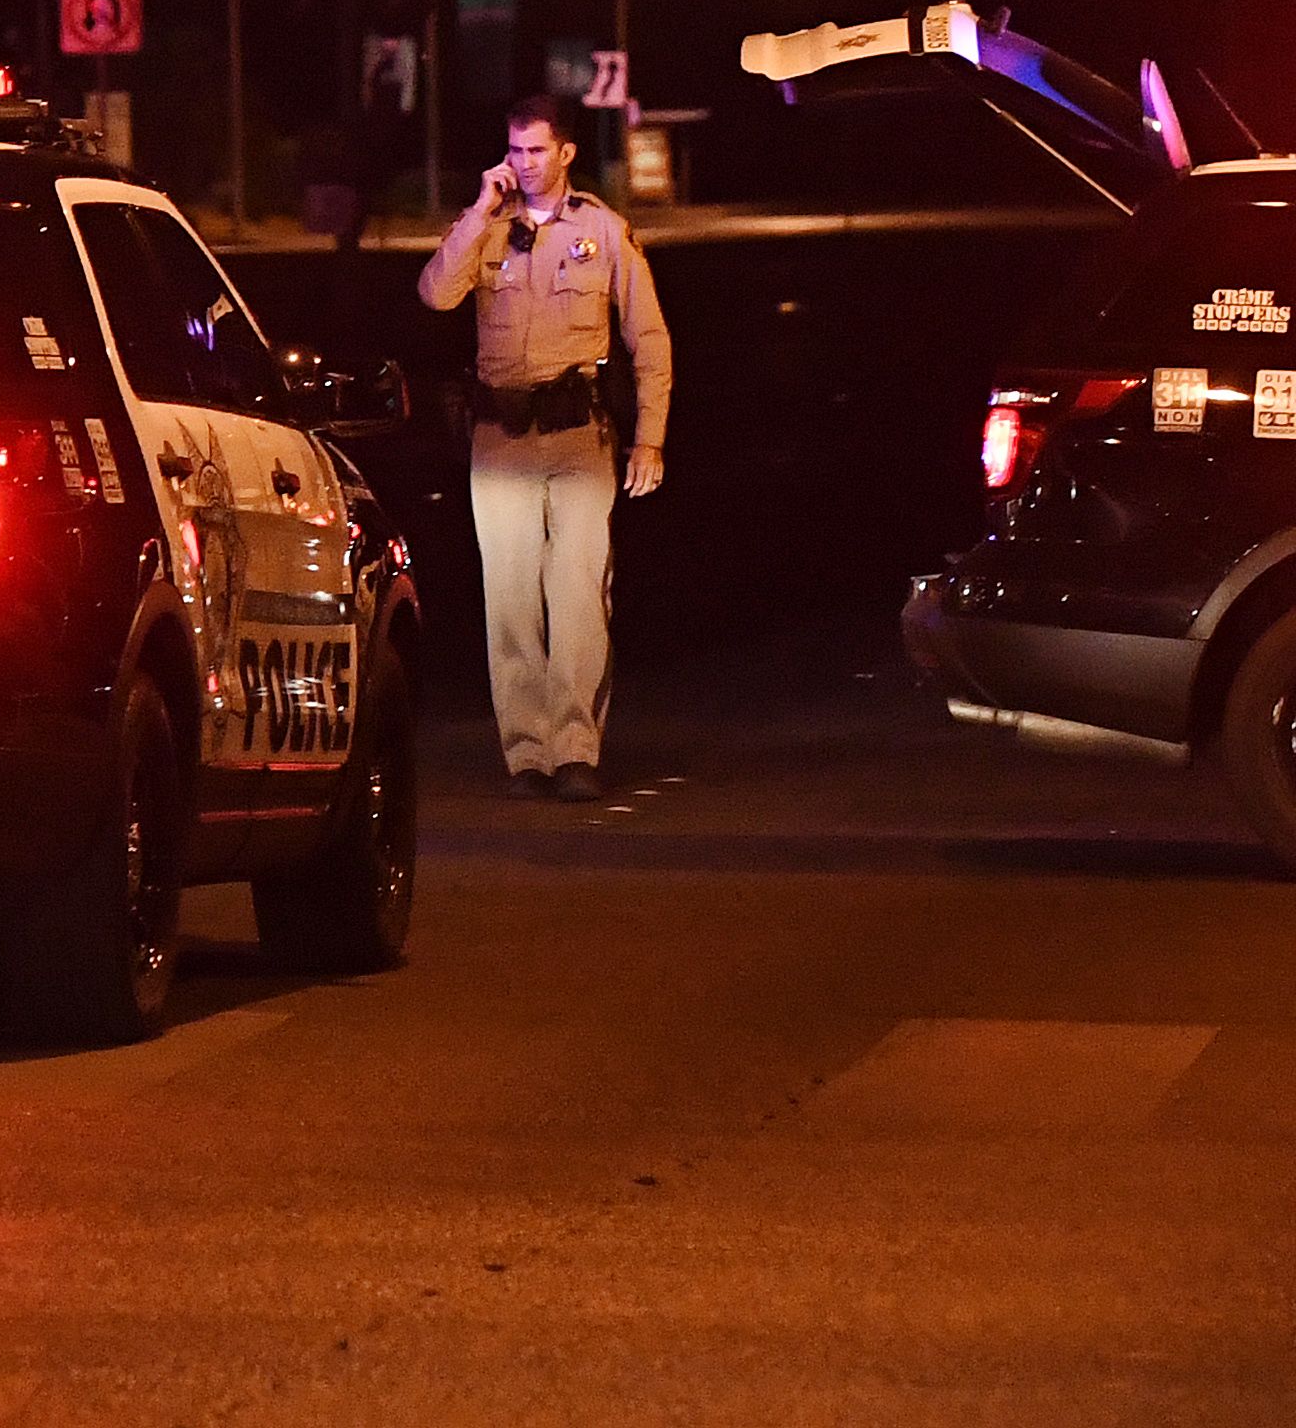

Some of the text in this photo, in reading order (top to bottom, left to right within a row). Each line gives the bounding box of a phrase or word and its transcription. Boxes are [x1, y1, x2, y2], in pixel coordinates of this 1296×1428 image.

[1193, 304, 1290, 321] STOPPERS
[1160, 371, 1201, 382] DIAL
[1156, 383, 1205, 408] 311
[1157, 410, 1200, 423] NON
[239, 639, 351, 754] POLICE
